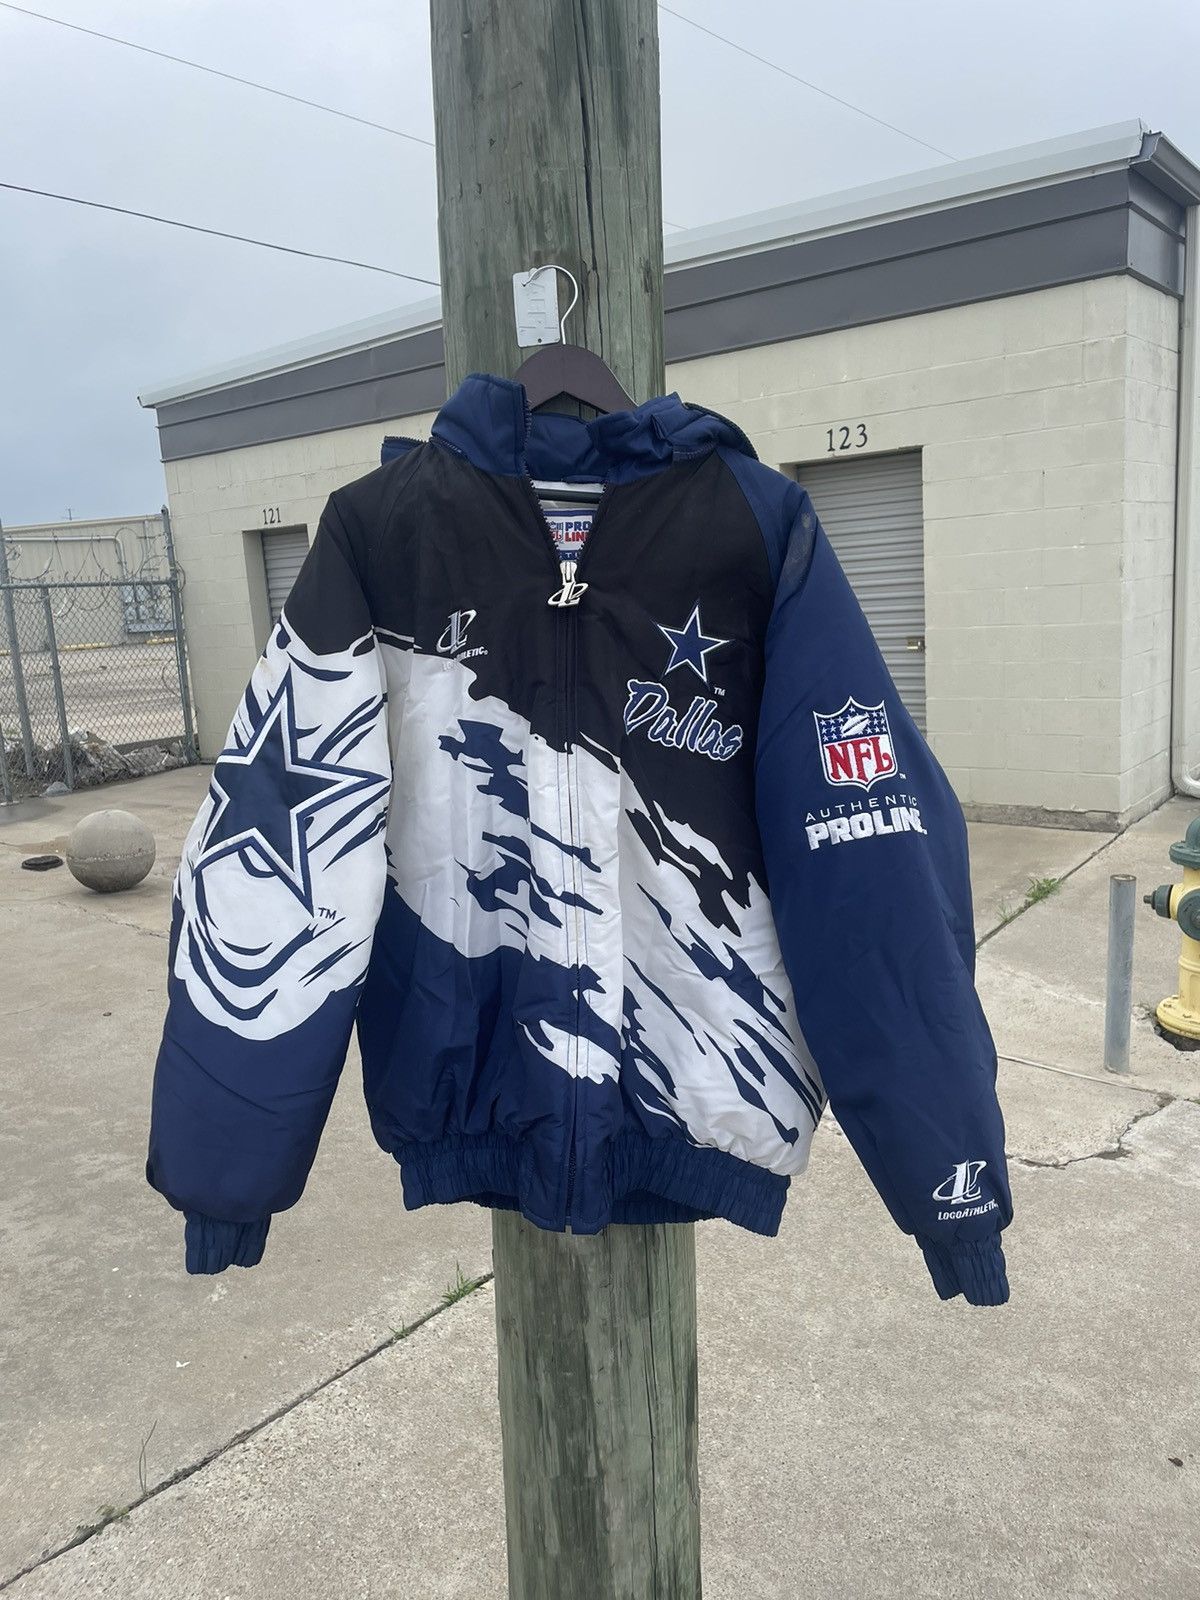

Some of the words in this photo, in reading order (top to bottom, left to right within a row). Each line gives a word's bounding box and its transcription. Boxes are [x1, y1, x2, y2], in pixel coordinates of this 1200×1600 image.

[826, 423, 868, 452] 123
[262, 507, 281, 525] 121
[565, 521, 592, 532] PRO
[623, 679, 743, 761] Dallas
[825, 736, 893, 782] NFL
[805, 794, 918, 823] AUTHENTIC
[318, 907, 337, 920] TM
